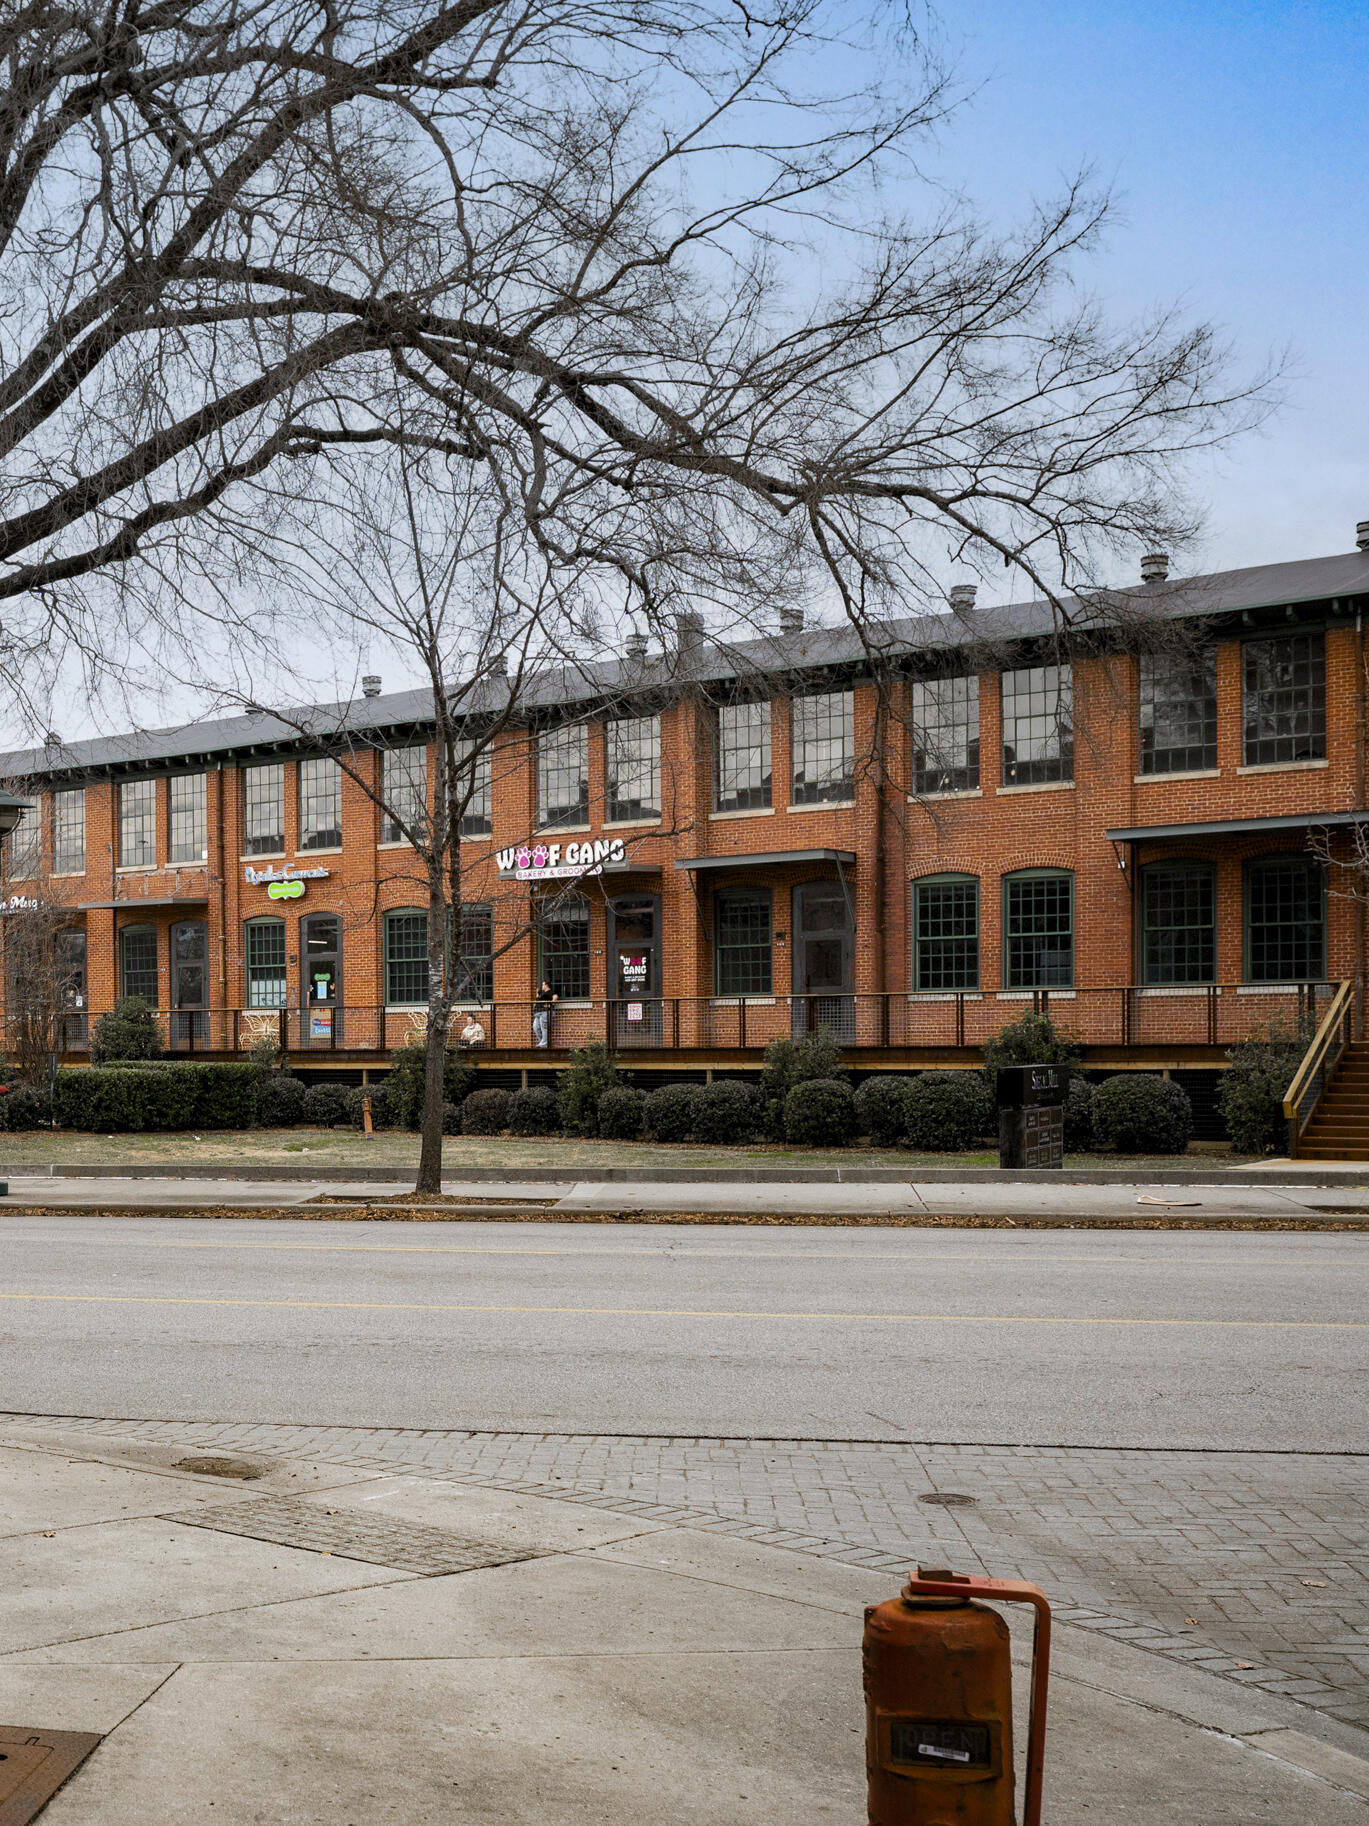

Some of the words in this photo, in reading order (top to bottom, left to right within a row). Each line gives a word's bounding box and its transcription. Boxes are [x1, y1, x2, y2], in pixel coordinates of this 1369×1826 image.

[565, 838, 625, 865] GANG
[517, 868, 546, 879] BAKERY
[623, 965, 647, 975] GANG
